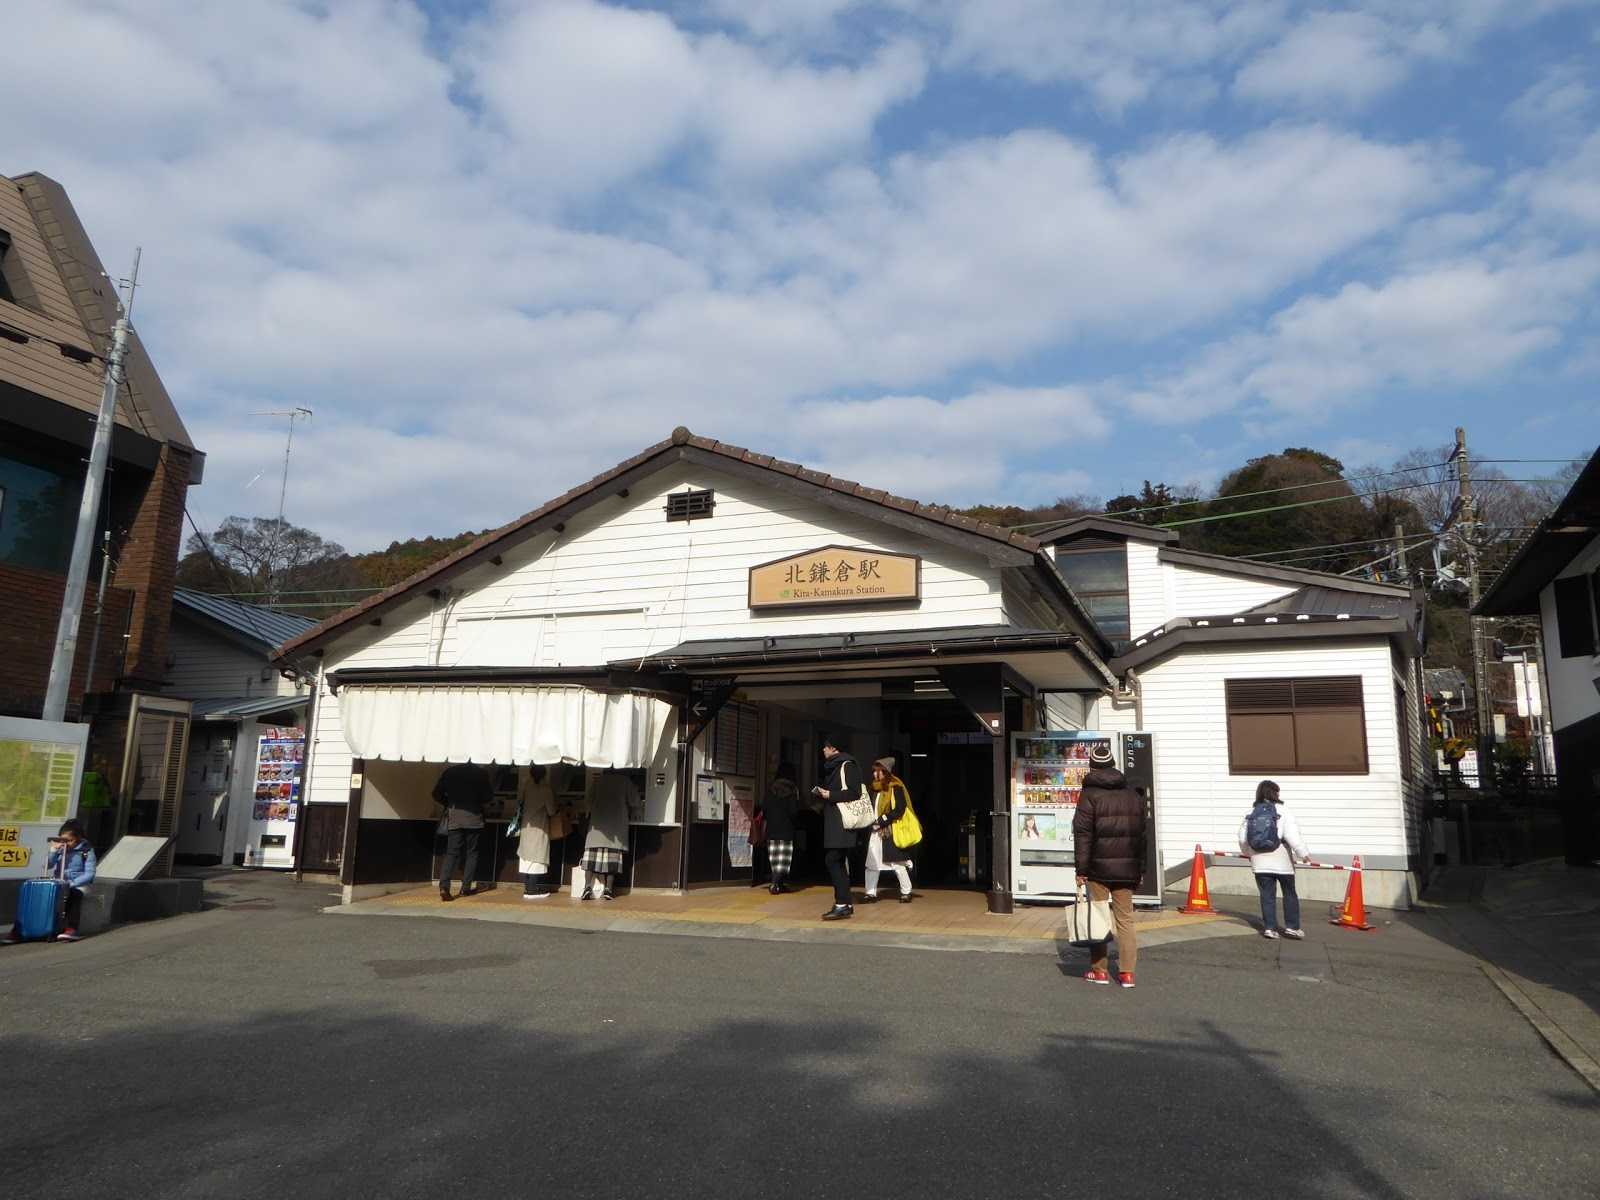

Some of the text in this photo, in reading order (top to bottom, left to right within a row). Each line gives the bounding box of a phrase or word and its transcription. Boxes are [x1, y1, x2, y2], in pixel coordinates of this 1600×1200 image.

[784, 559, 881, 584] 北鎌倉駅
[793, 587, 854, 599] Kita-Kamakura
[856, 584, 885, 595] Station
[0, 849, 28, 863] さい
